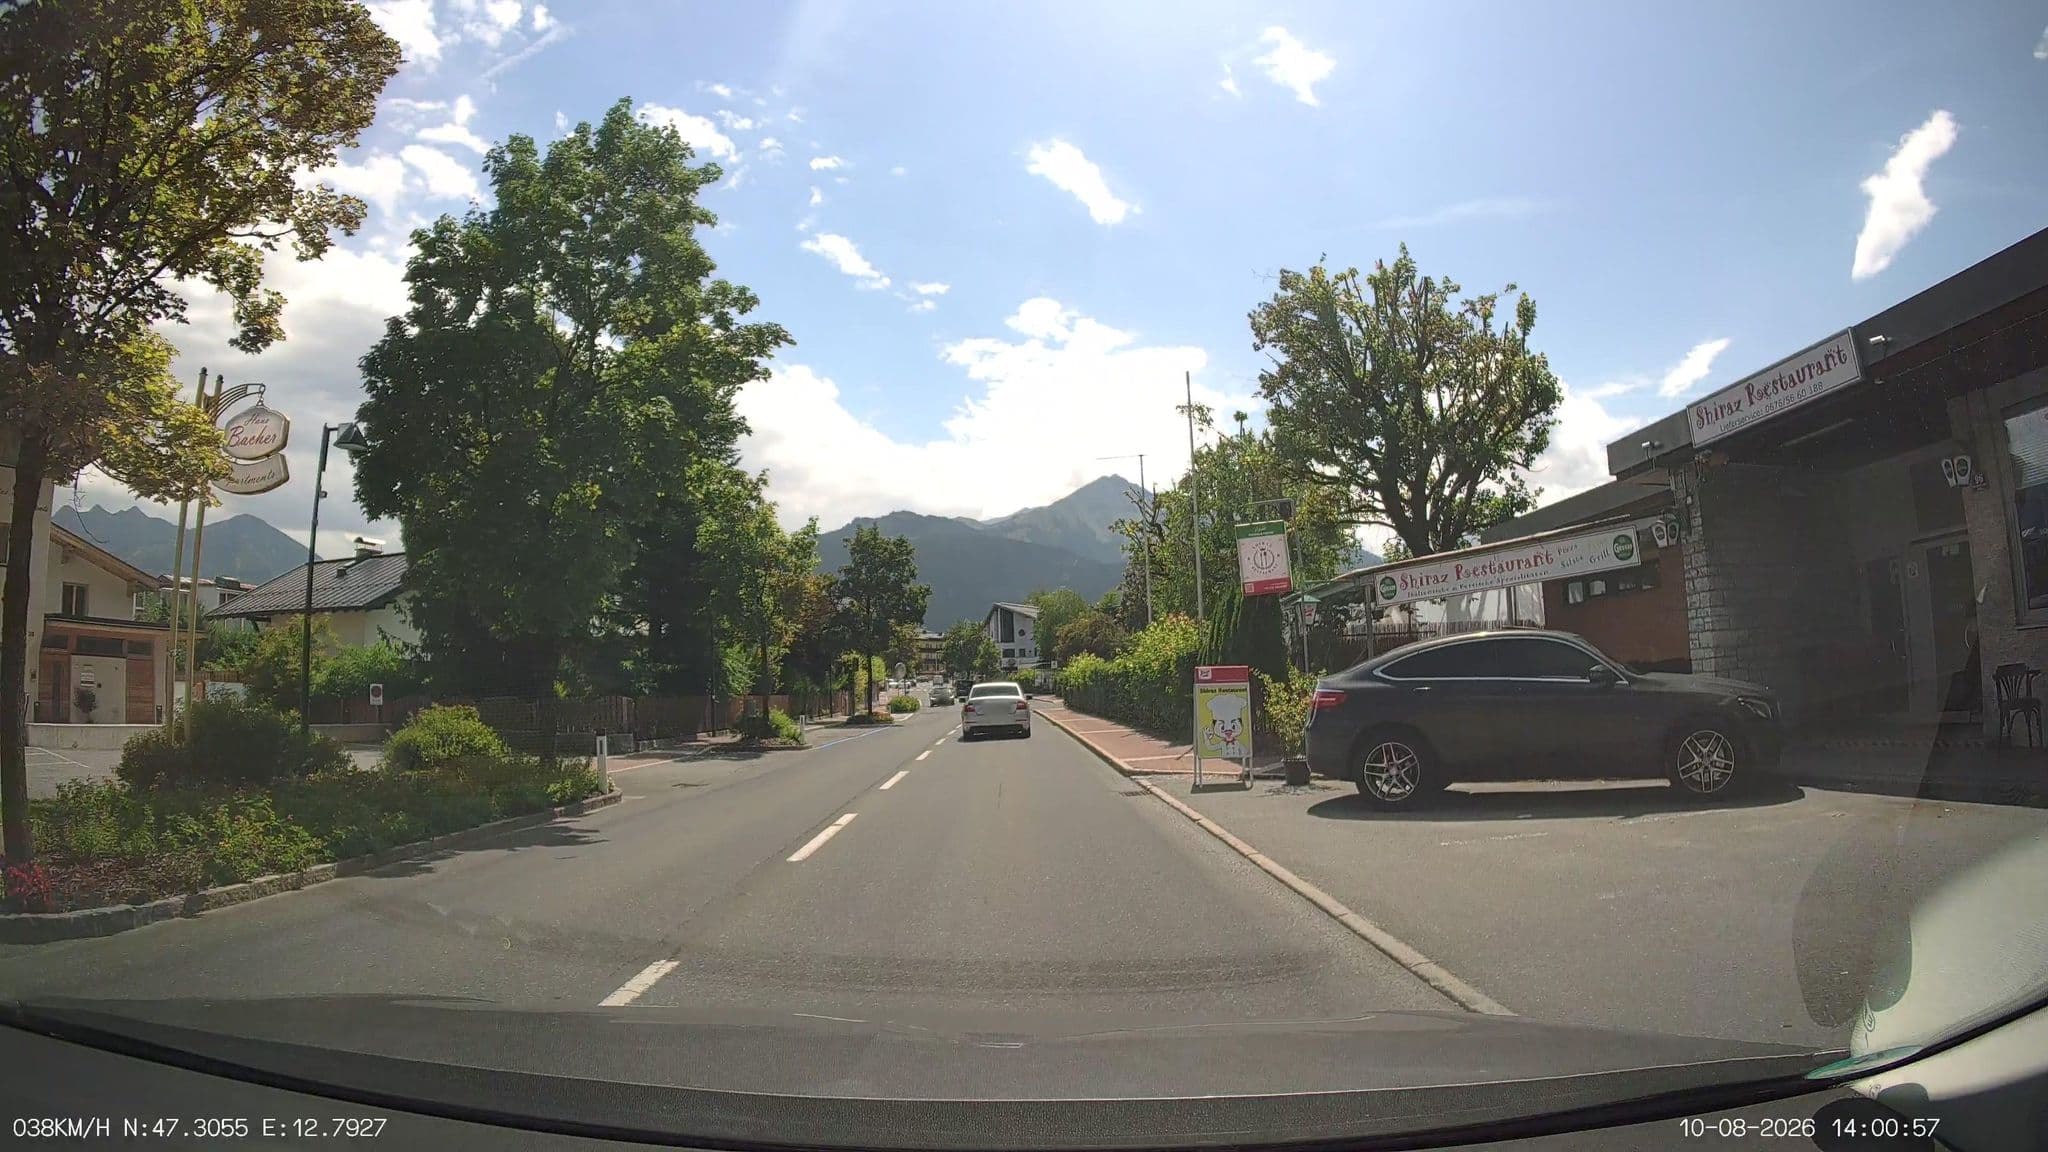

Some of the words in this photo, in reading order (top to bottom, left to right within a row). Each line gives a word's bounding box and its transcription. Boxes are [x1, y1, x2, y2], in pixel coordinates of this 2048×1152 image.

[1696, 399, 1744, 430] Shiraz
[1744, 344, 1848, 408] Restaurant
[229, 425, 277, 448] Bacher
[1400, 570, 1449, 591] Shiraz
[1455, 549, 1554, 582] Restaurant
